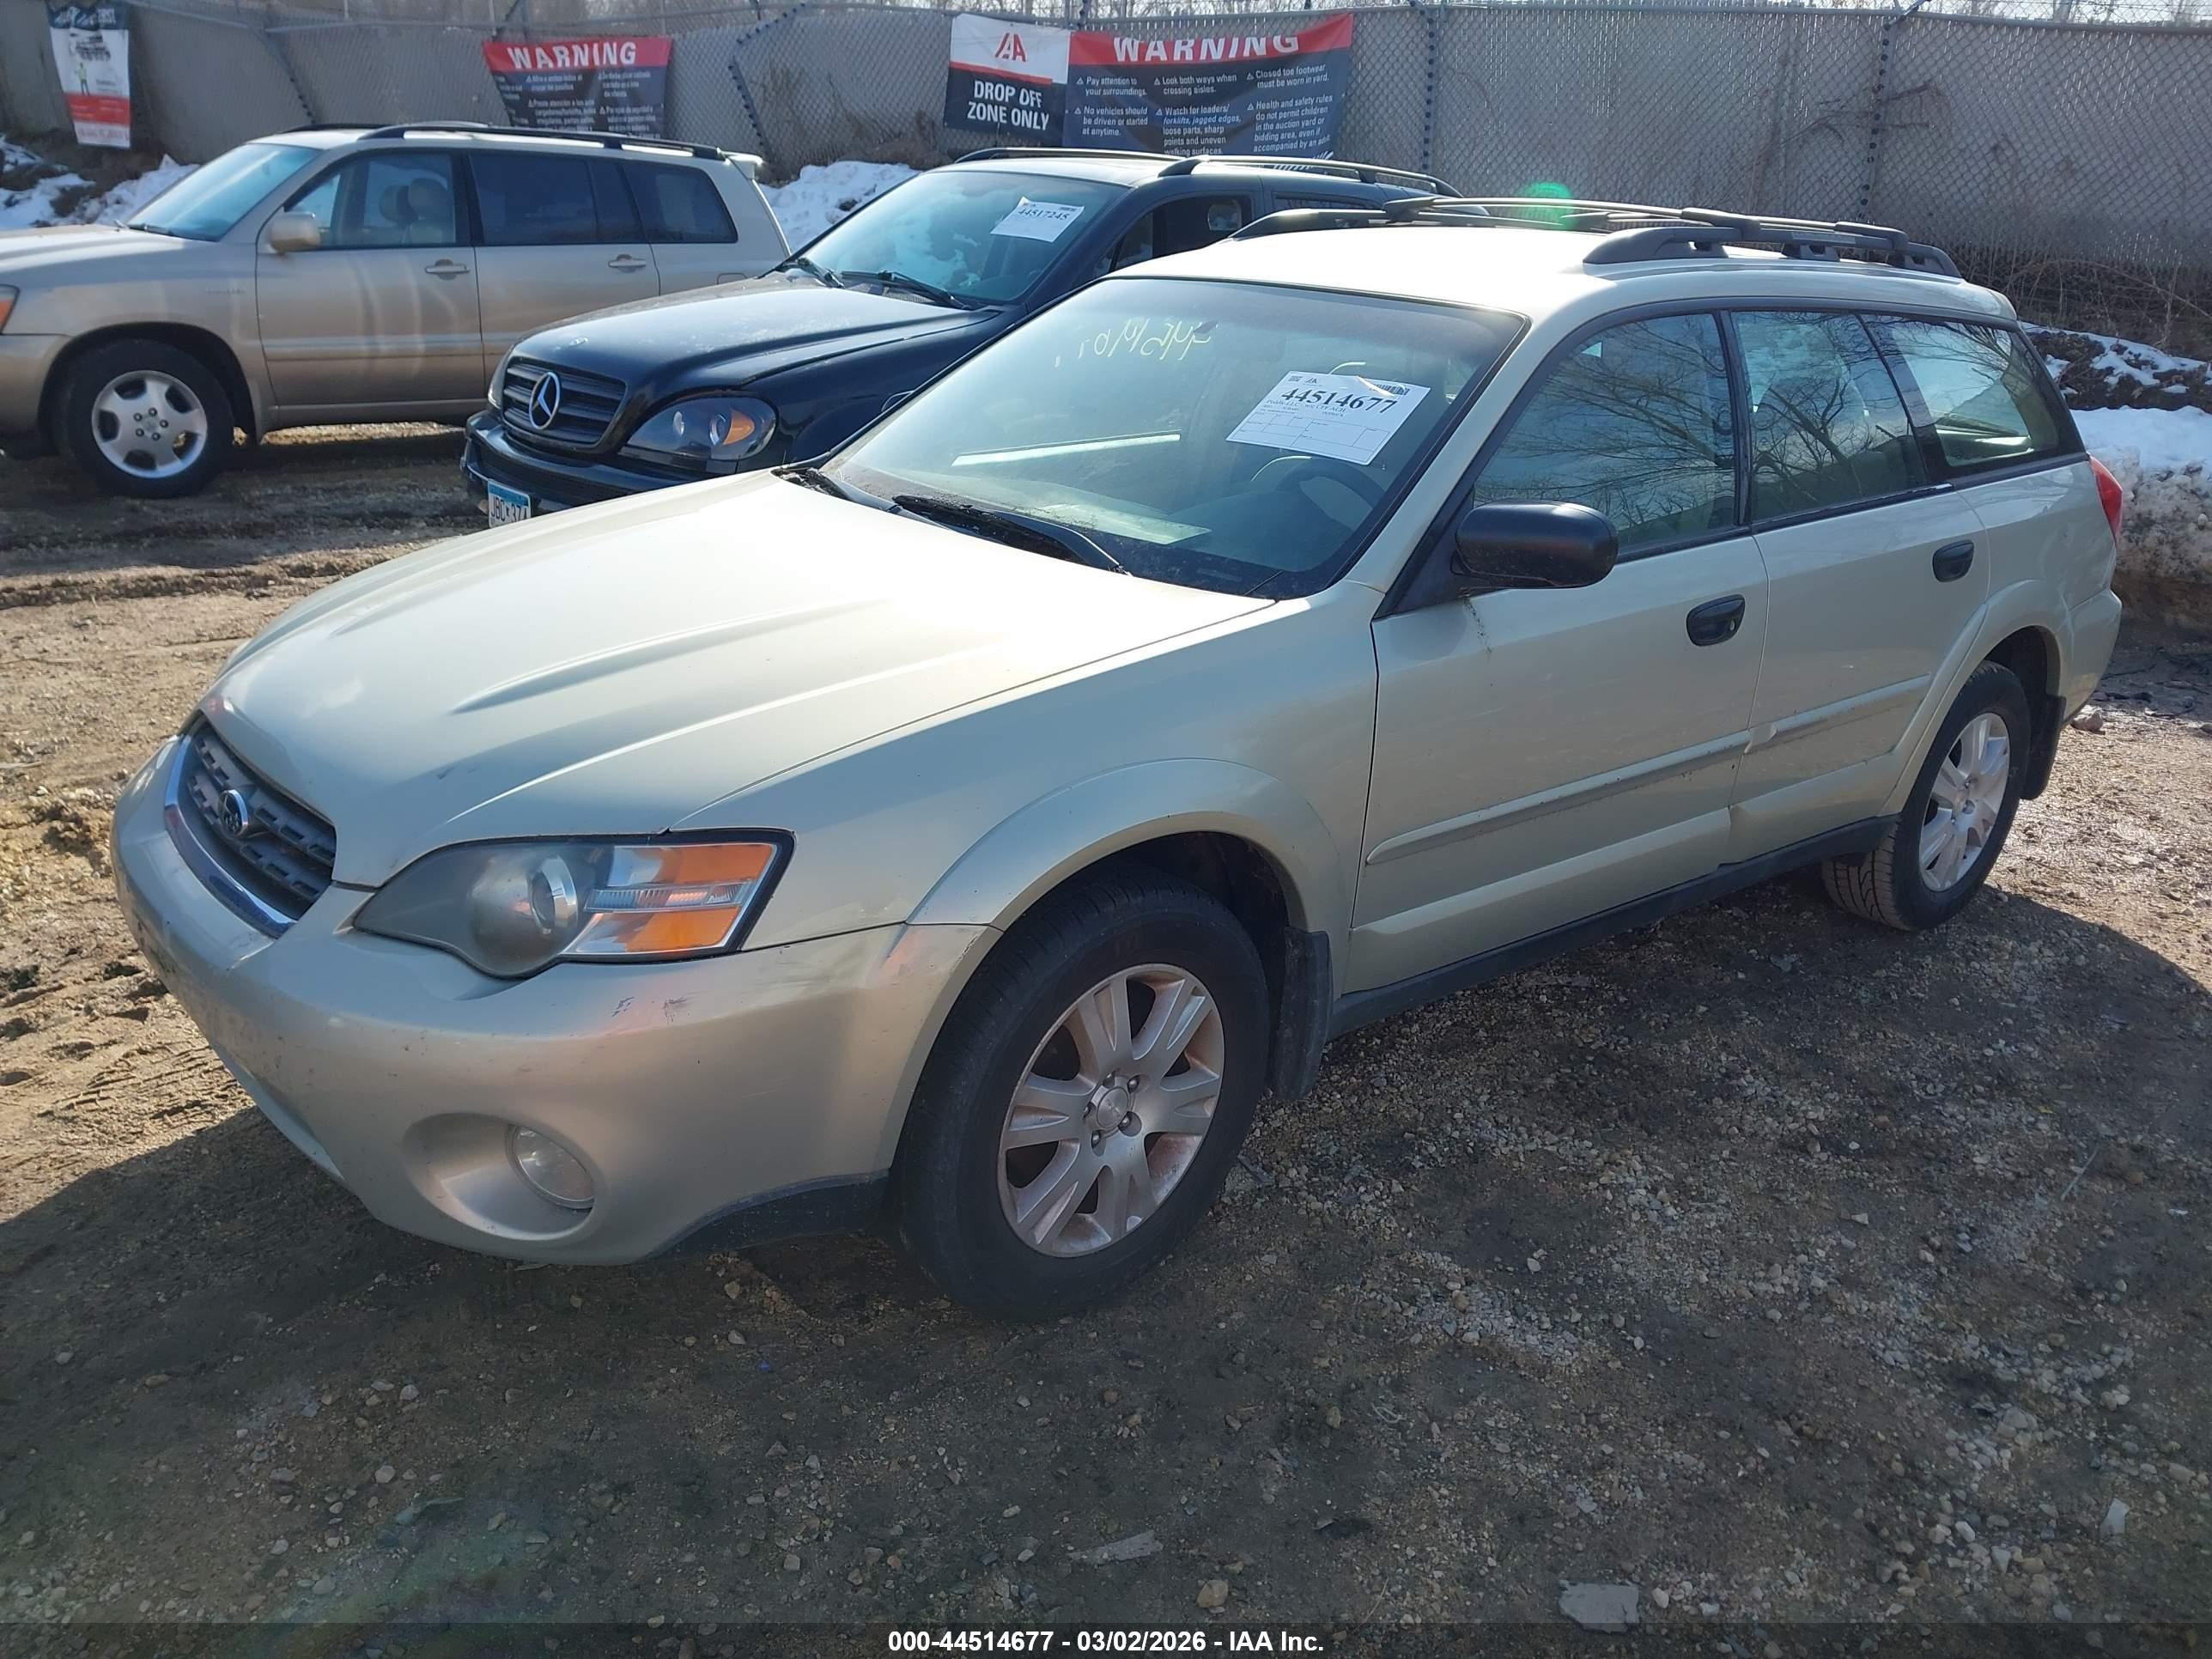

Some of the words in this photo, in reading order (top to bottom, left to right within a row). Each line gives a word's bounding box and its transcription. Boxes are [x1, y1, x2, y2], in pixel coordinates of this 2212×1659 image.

[1114, 34, 1299, 62] WARNING
[507, 41, 636, 70] WARNING
[1255, 69, 1281, 79] Closed
[1283, 68, 1294, 76] toe
[1296, 64, 1326, 74] footwear
[1086, 76, 1099, 86] Pay
[1101, 77, 1130, 85] attention
[1162, 76, 1178, 85] Look
[1179, 75, 1195, 84] both
[1195, 76, 1215, 85] ways
[1216, 74, 1237, 82] when
[1257, 80, 1275, 88] must
[1276, 78, 1285, 87] be
[1286, 78, 1305, 86] worn
[1313, 73, 1329, 84] yard.
[974, 80, 1015, 103] DROP
[1019, 88, 1042, 108] OFF
[1085, 88, 1101, 97] your
[1103, 88, 1147, 97] surroundings.
[1163, 87, 1192, 96] crossing
[1194, 85, 1216, 94] aisles.
[1256, 100, 1280, 110] Health
[1281, 98, 1293, 108] and
[1294, 95, 1315, 106] safety
[1315, 94, 1333, 103] rules
[967, 101, 1007, 124] ZONE
[1011, 107, 1049, 131] ONLY
[1084, 105, 1095, 114] No
[1096, 106, 1124, 115] vehicles
[1125, 106, 1148, 115] should
[1165, 106, 1188, 116] Watch
[1189, 106, 1200, 114] for
[1201, 103, 1230, 114] loaders/
[1255, 112, 1265, 121] do
[1279, 111, 1300, 120] permit
[1301, 105, 1328, 115] children
[1083, 116, 1092, 125] be
[1094, 116, 1116, 125] driven
[1126, 117, 1148, 126] started
[1163, 116, 1191, 125] forklifts,
[1192, 115, 1217, 125] jagged
[1218, 114, 1241, 123] edges,
[1255, 123, 1262, 131] in
[1263, 122, 1274, 130] the
[1275, 120, 1300, 130] auction
[1301, 117, 1316, 127] yard
[1091, 128, 1121, 137] anytime.
[1163, 126, 1182, 135] loose
[1183, 126, 1202, 136] parts,
[1204, 125, 1224, 134] sharp
[1254, 132, 1279, 142] bidding
[1280, 131, 1297, 140] area,
[1299, 129, 1315, 137] even
[1316, 127, 1321, 136] if
[1164, 137, 1185, 147] points
[1186, 136, 1198, 145] and
[1254, 140, 1298, 152] accompanied
[1299, 140, 1307, 149] by
[1309, 139, 1317, 147] an
[1164, 146, 1191, 157] walking
[1191, 146, 1223, 155] surfaces.
[1018, 208, 1070, 220] 44517245
[1281, 387, 1398, 414] 44514677
